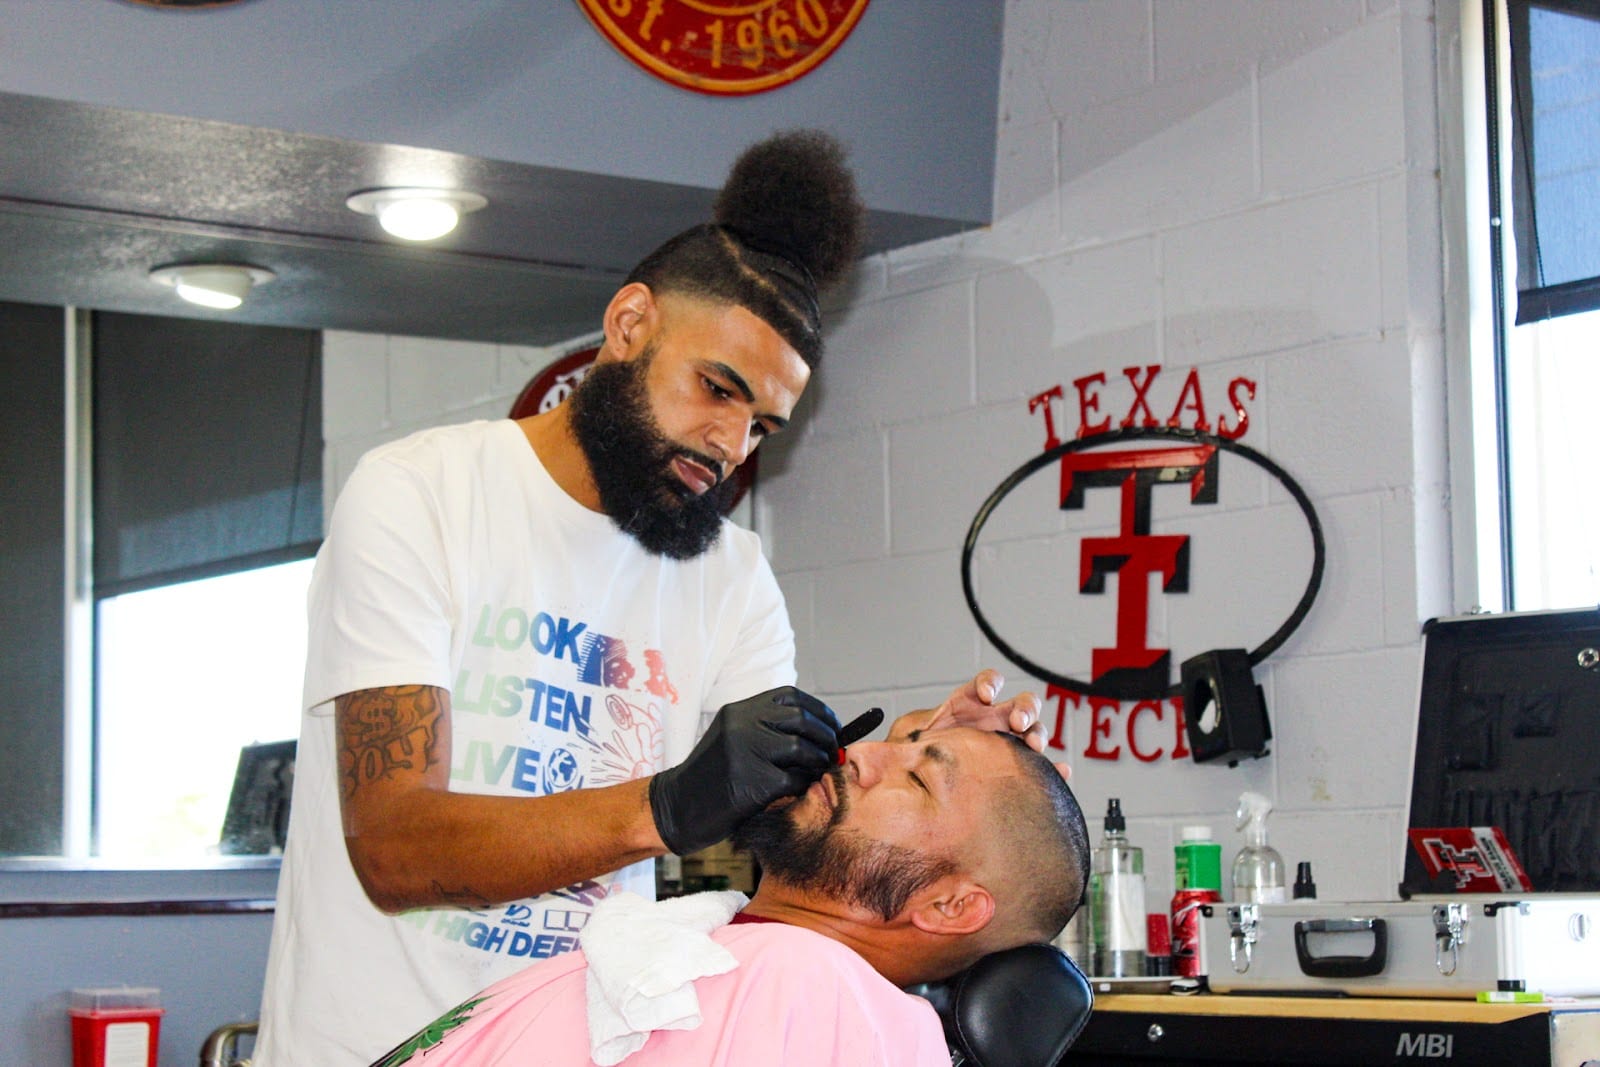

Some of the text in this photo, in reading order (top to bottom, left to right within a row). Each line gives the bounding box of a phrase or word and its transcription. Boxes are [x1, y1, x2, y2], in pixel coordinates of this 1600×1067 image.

[704, 0, 828, 69] 1960
[1029, 364, 1257, 452] TEXAS
[472, 604, 588, 665] LOOK
[453, 669, 591, 735] LISTEN
[431, 910, 508, 954] HIGH
[1395, 1032, 1454, 1058] MBI
